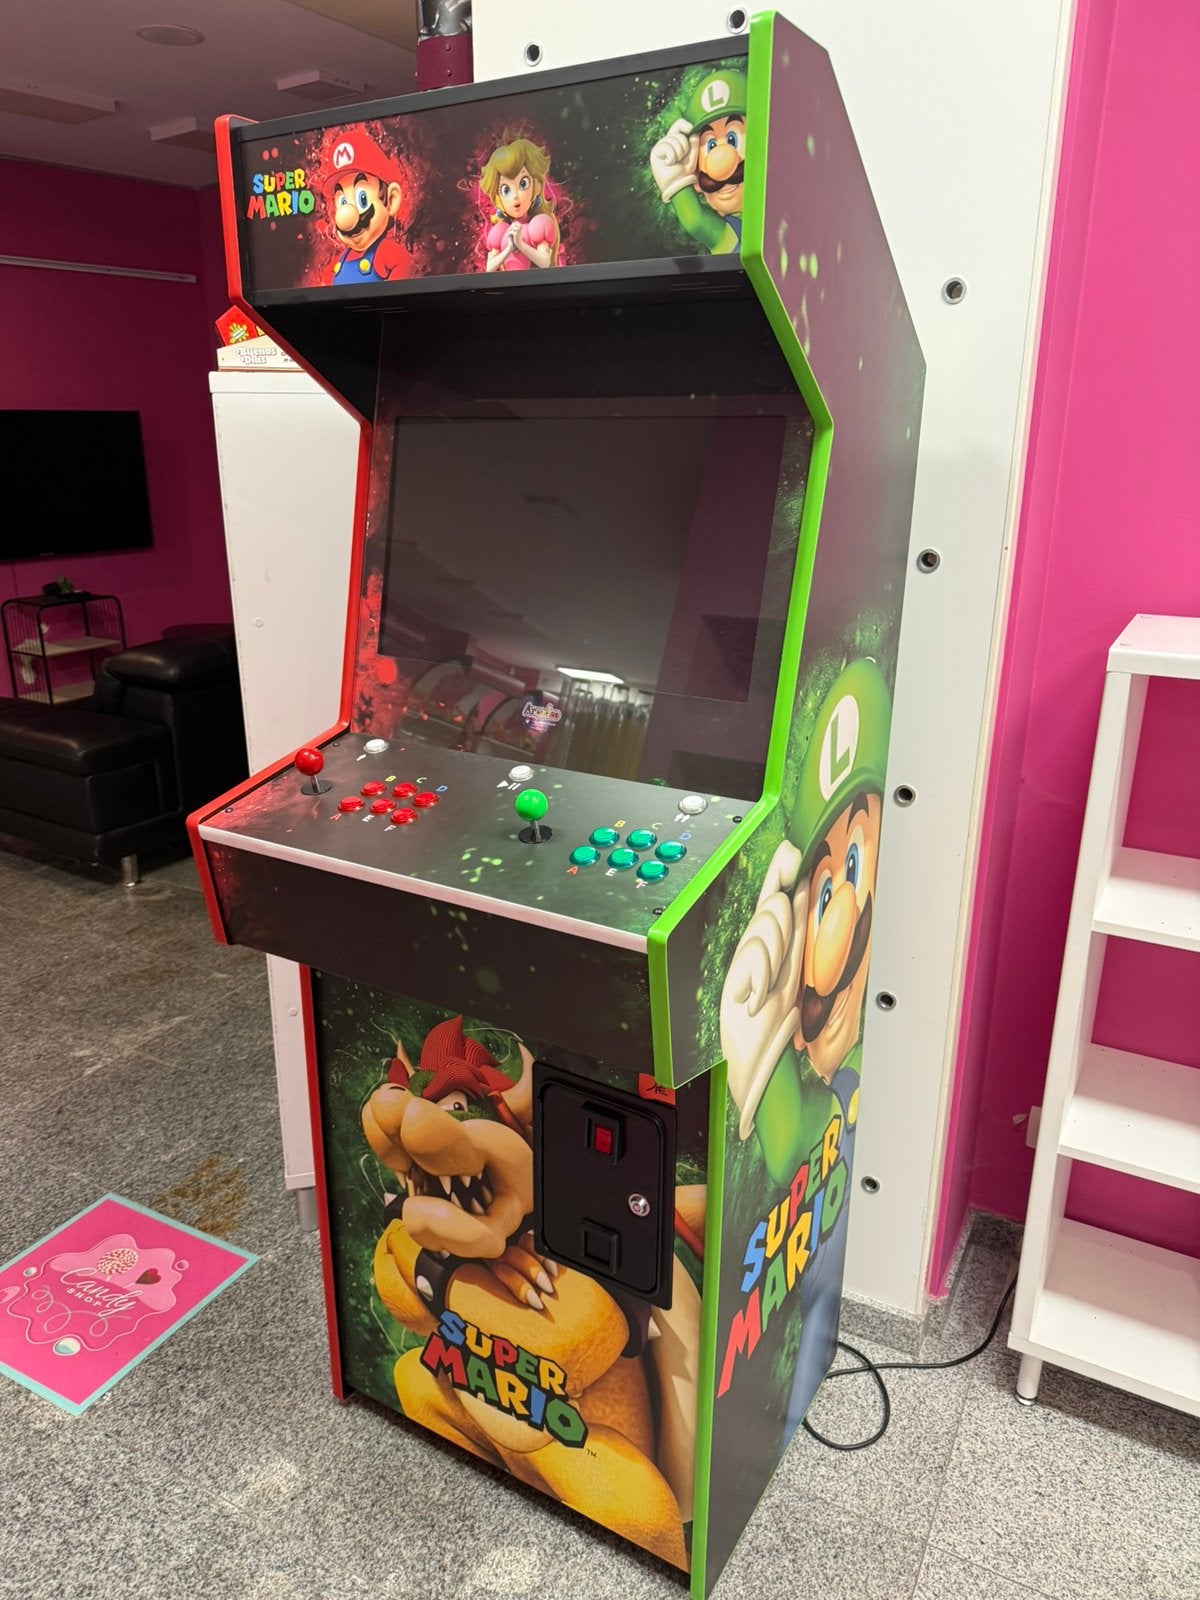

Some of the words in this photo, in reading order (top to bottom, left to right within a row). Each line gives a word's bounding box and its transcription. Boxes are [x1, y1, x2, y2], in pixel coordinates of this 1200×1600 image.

[707, 85, 725, 107] L
[335, 145, 353, 167] M
[252, 167, 306, 194] SUPER
[246, 189, 316, 220] MARIO
[236, 347, 277, 357] Buenos
[830, 712, 851, 786] L
[330, 813, 342, 821] A
[362, 814, 375, 822] E
[614, 820, 626, 828] B
[651, 822, 663, 830] C
[384, 824, 397, 832] F
[678, 832, 692, 841] D
[566, 866, 579, 875] A
[605, 868, 618, 877] E
[636, 881, 648, 889] F
[740, 1115, 842, 1294] SUPER
[717, 1159, 848, 1399] MARIO
[60, 1267, 145, 1318] Candy
[67, 1287, 102, 1307] SHOP
[438, 1309, 568, 1401] SUPER
[420, 1332, 588, 1449] MARIO
